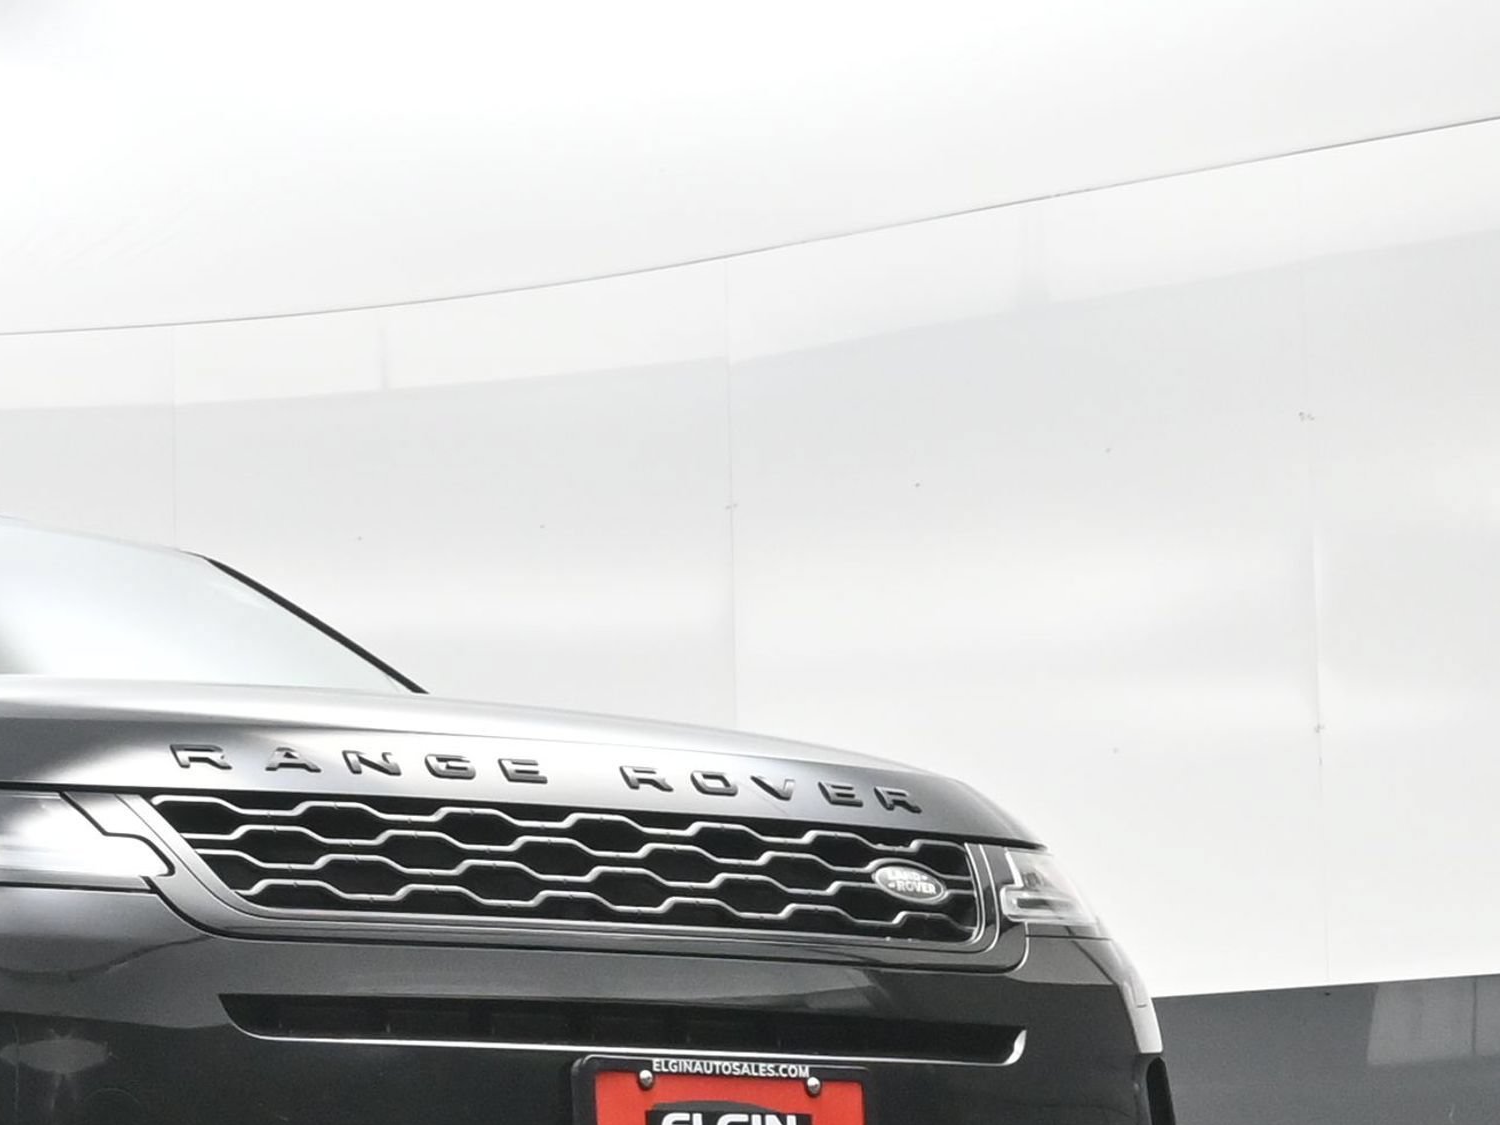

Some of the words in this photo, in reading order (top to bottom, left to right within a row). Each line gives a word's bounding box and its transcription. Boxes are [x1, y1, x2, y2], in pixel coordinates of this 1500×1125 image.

[169, 743, 548, 784] RANGE
[619, 765, 922, 814] ROVER
[896, 880, 937, 894] ROVER
[651, 1058, 810, 1078] ELGINAUTOSALES.COM
